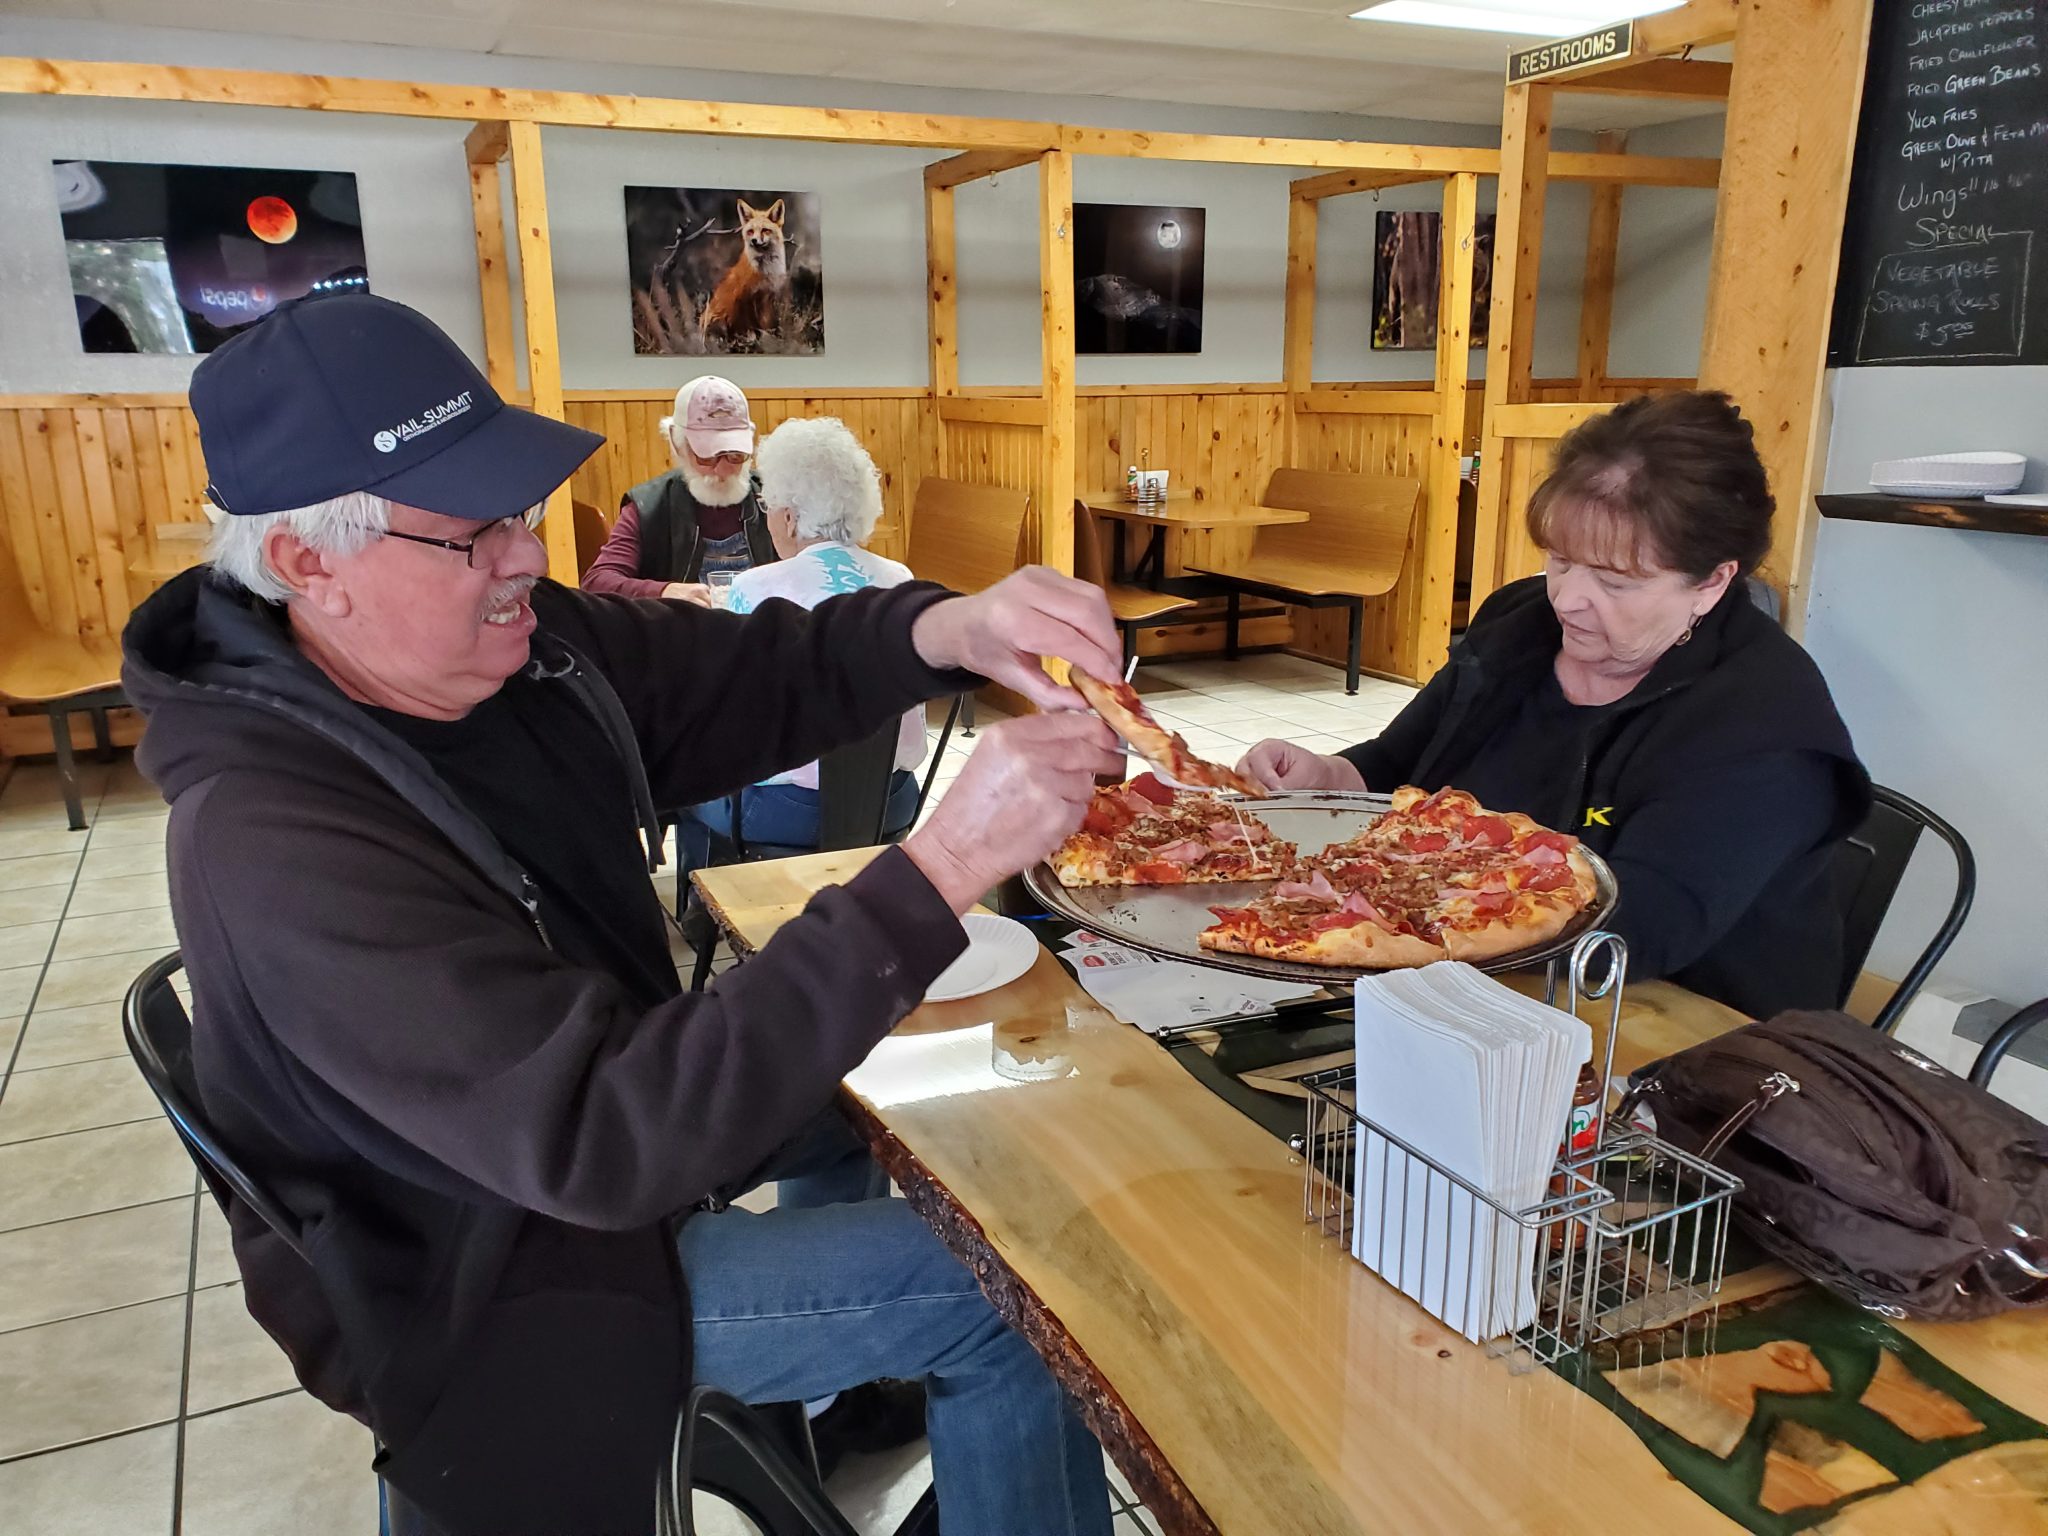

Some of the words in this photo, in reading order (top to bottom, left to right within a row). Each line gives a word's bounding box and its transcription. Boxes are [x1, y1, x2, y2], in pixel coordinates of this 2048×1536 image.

[1520, 31, 1616, 75] RESTROOMS
[1910, 55, 1943, 71] FRIED
[1908, 82, 1940, 97] FRIED
[1945, 74, 1987, 94] GREEN
[1990, 63, 2041, 86] BEANS
[1907, 109, 1937, 133] YUCA
[1943, 107, 1978, 124] FRIES
[1901, 141, 1942, 161] GREEK
[1905, 217, 1994, 247] SPECIAL
[389, 391, 473, 439] VAIL-SUMMIT
